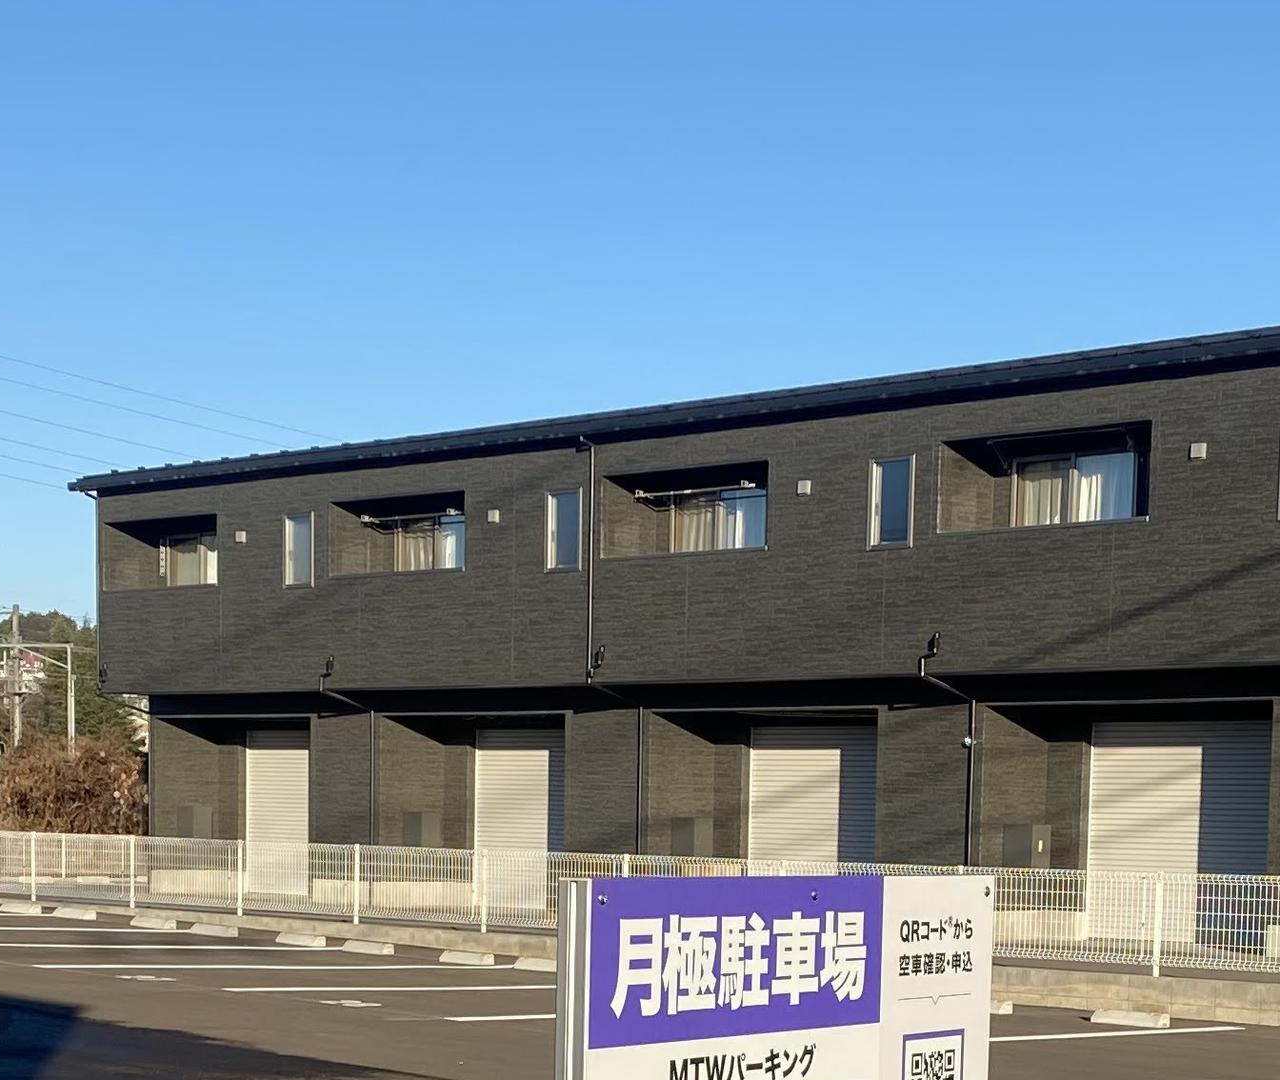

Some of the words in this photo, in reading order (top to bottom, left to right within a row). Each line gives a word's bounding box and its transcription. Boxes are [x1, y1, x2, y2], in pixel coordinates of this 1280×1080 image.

[610, 911, 867, 1019] 月極駐車場
[898, 951, 973, 976] 空車確認・申込
